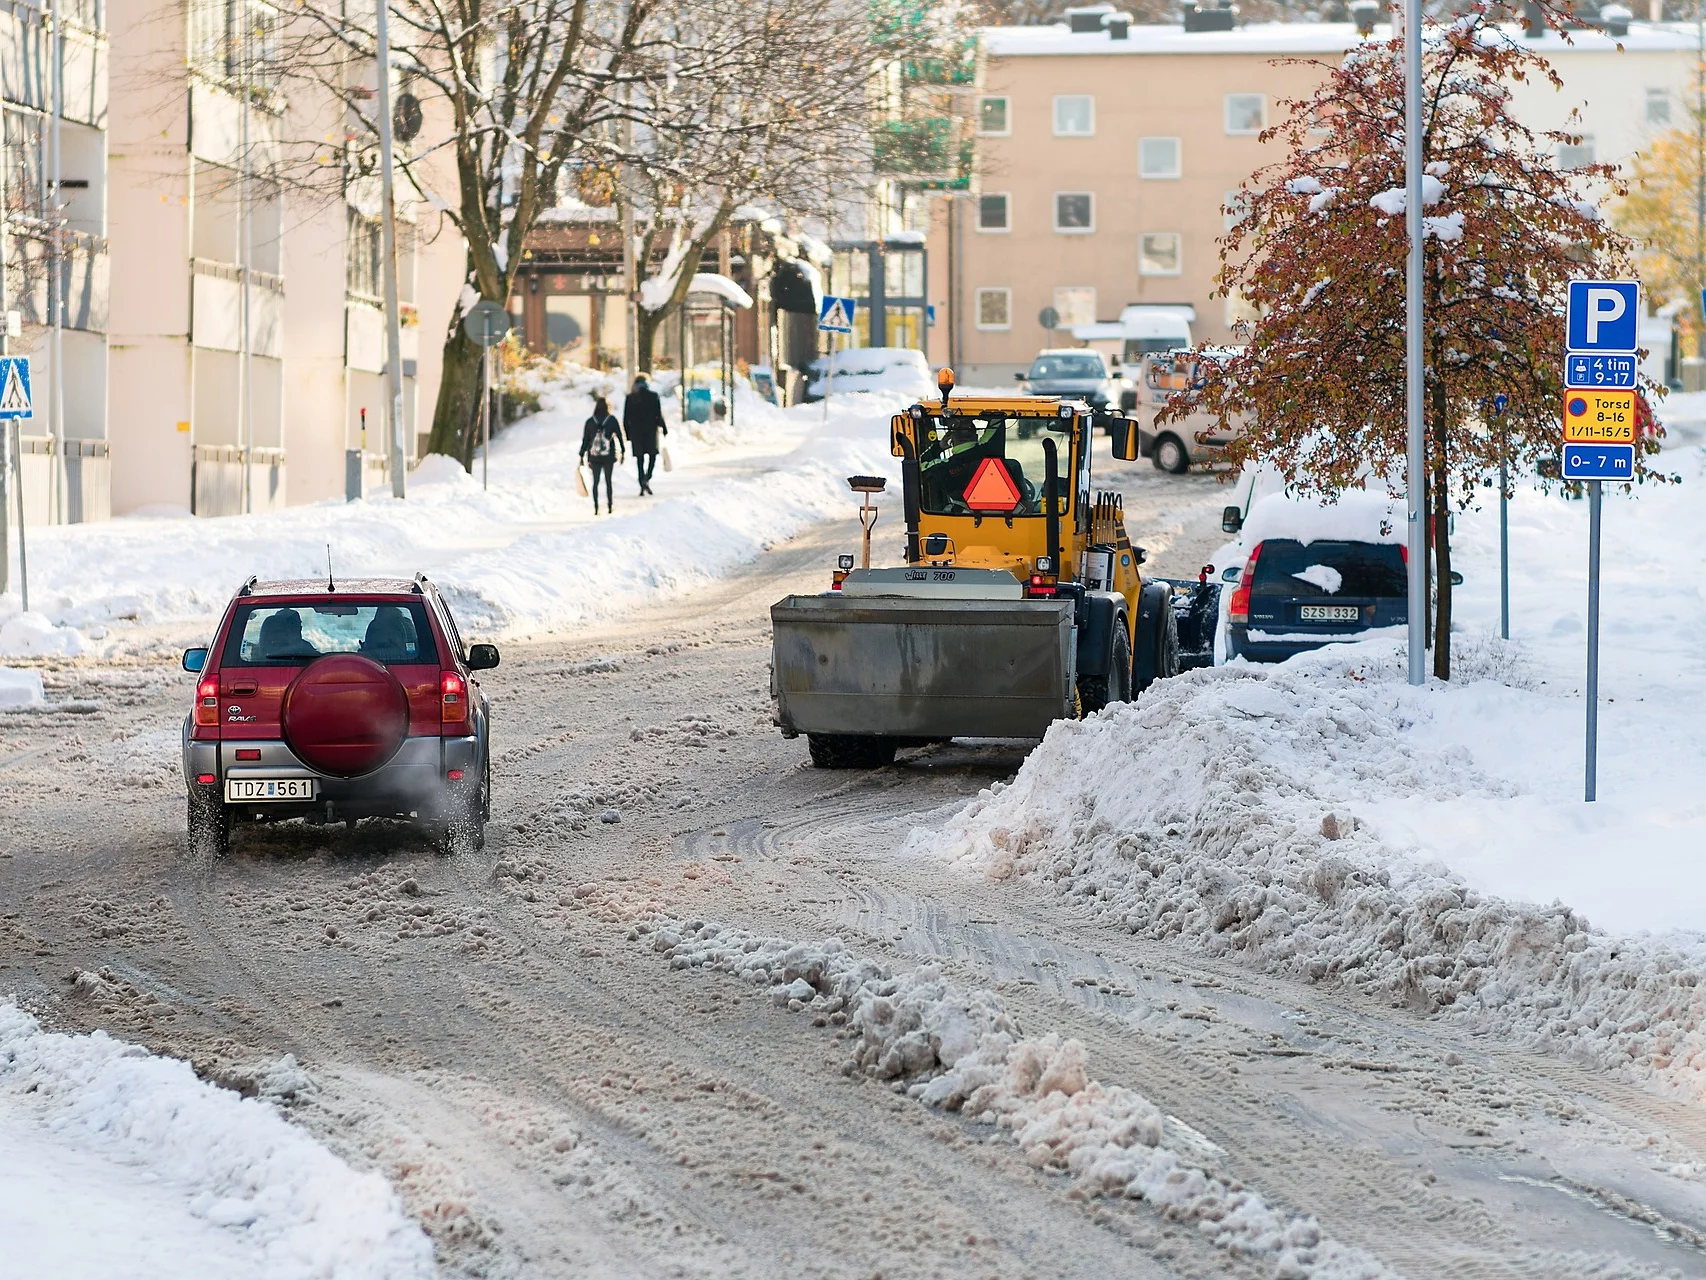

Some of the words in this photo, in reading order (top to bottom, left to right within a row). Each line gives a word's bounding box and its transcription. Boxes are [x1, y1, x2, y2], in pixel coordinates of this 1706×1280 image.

[1587, 288, 1626, 343] P
[1593, 358, 1603, 370] 4
[1607, 358, 1630, 370] tim
[1595, 372, 1629, 384] 9-17
[1595, 398, 1630, 409] Torsd
[1597, 412, 1625, 422] 8-16
[1571, 426, 1630, 437] 1/11-15/5
[1597, 455, 1607, 468] 7
[1614, 458, 1626, 468] m
[933, 571, 956, 581] 700
[1302, 607, 1326, 618] SZS
[1333, 608, 1357, 619] 332
[234, 782, 264, 796] TDZ
[277, 782, 307, 796] 561
